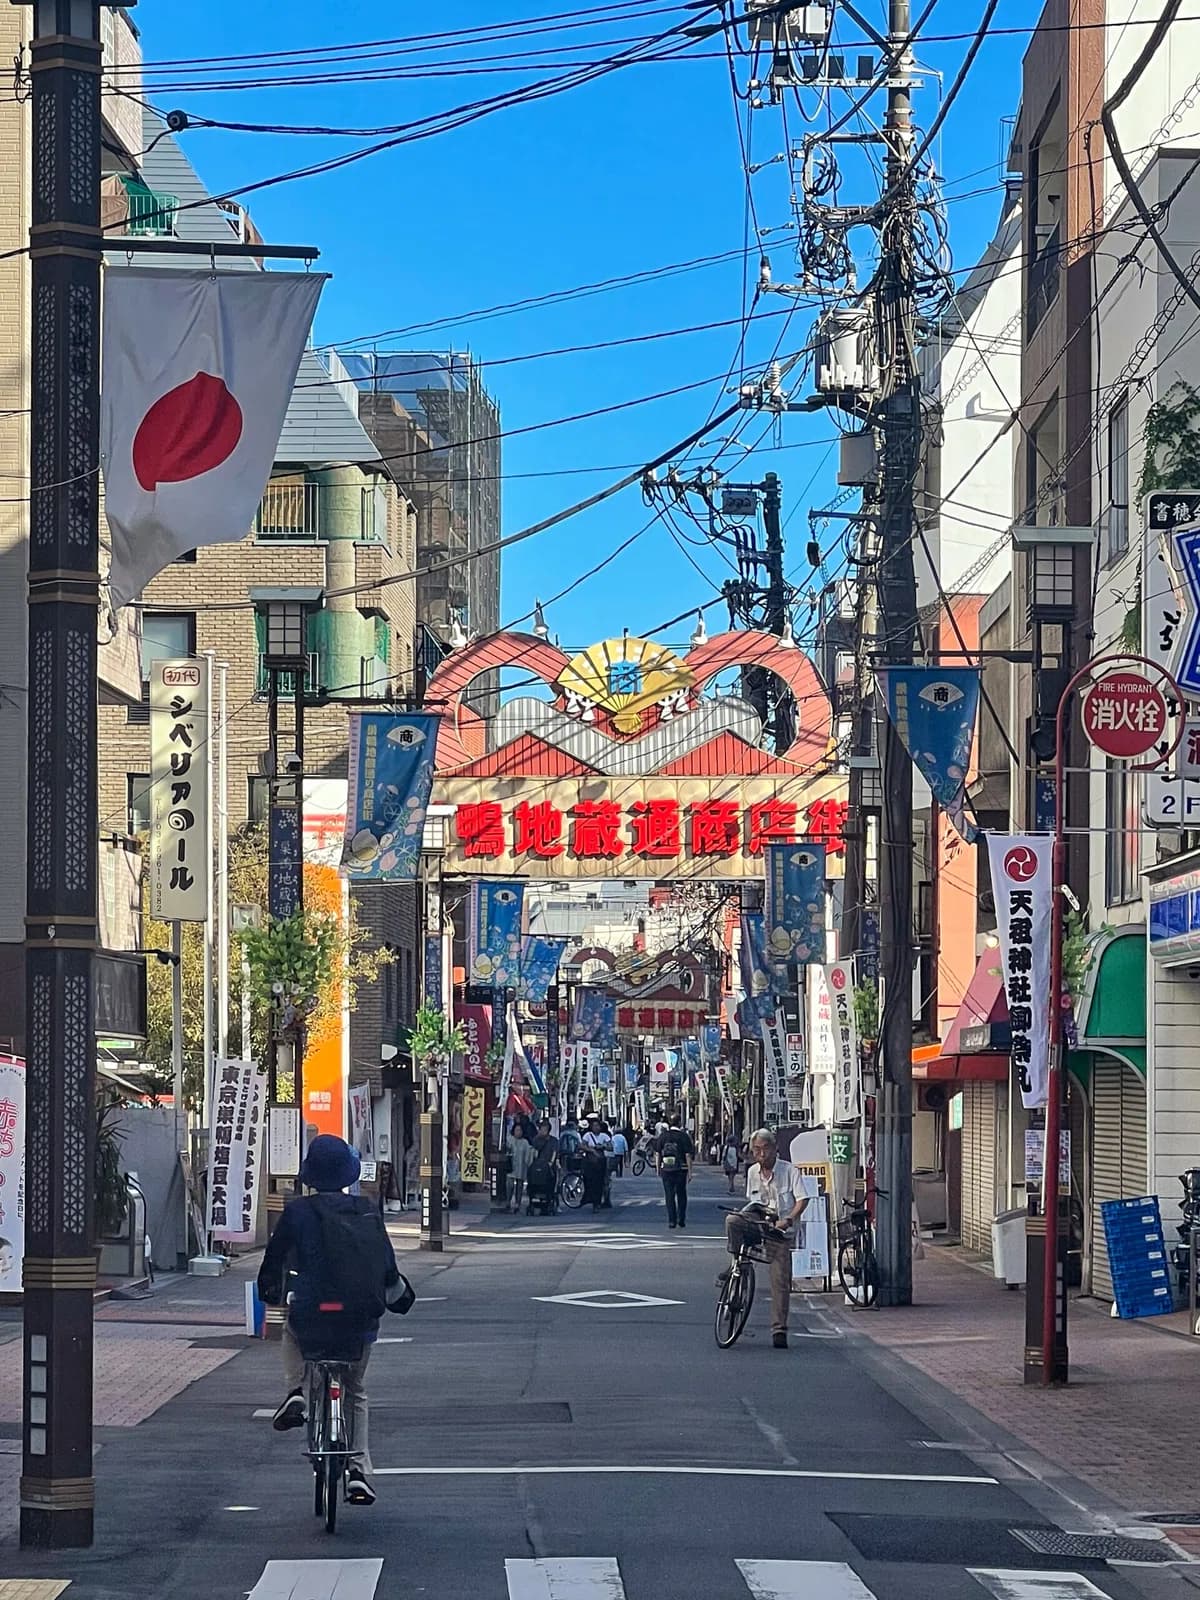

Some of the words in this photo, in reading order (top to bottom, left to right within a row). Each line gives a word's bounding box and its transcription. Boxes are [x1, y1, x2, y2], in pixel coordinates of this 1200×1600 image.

[166, 670, 197, 682] 初代
[932, 687, 950, 703] 商
[1098, 683, 1116, 693] FIRE
[1117, 683, 1154, 694] HYDRANT
[1091, 697, 1161, 732] 消火栓
[399, 729, 414, 744] 商
[432, 799, 849, 857] 鴨地蔵通商店街
[1007, 889, 1034, 1093] 天祖神社御祭礼
[211, 1065, 241, 1227] 東京巣鴨塩豆大福
[833, 1142, 848, 1158] 文
